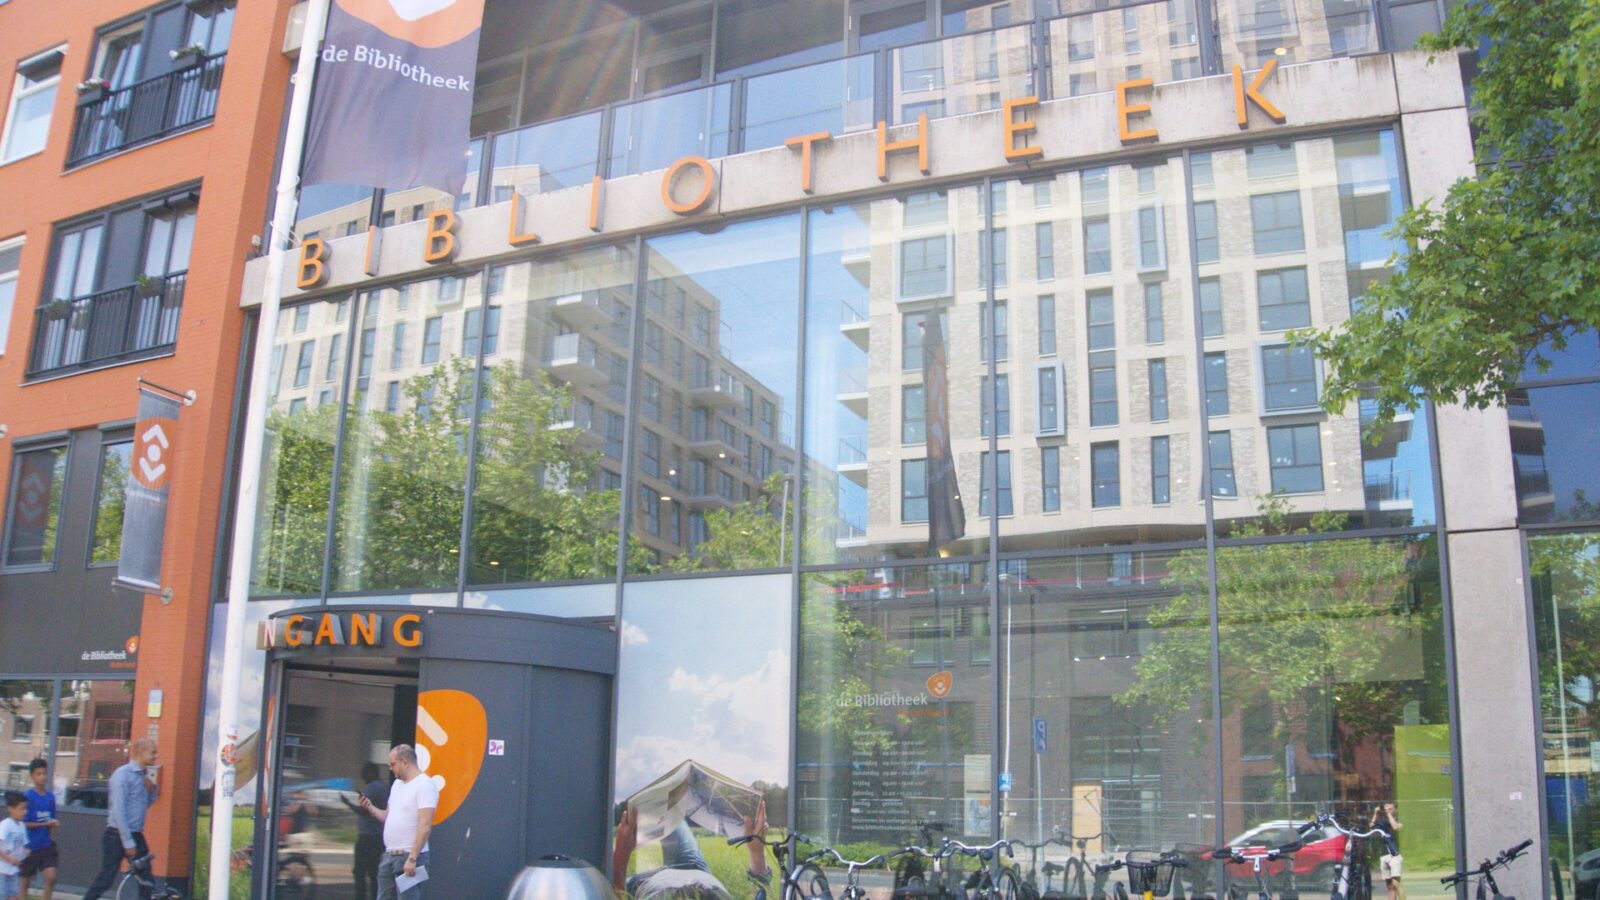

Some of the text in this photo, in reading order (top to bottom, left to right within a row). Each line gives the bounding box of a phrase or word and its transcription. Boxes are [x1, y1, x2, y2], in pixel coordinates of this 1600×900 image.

[321, 44, 472, 92] de Bibliotheek
[296, 58, 1287, 291] BIBLIOTHEEK
[836, 692, 929, 708] de Bibliotheek
